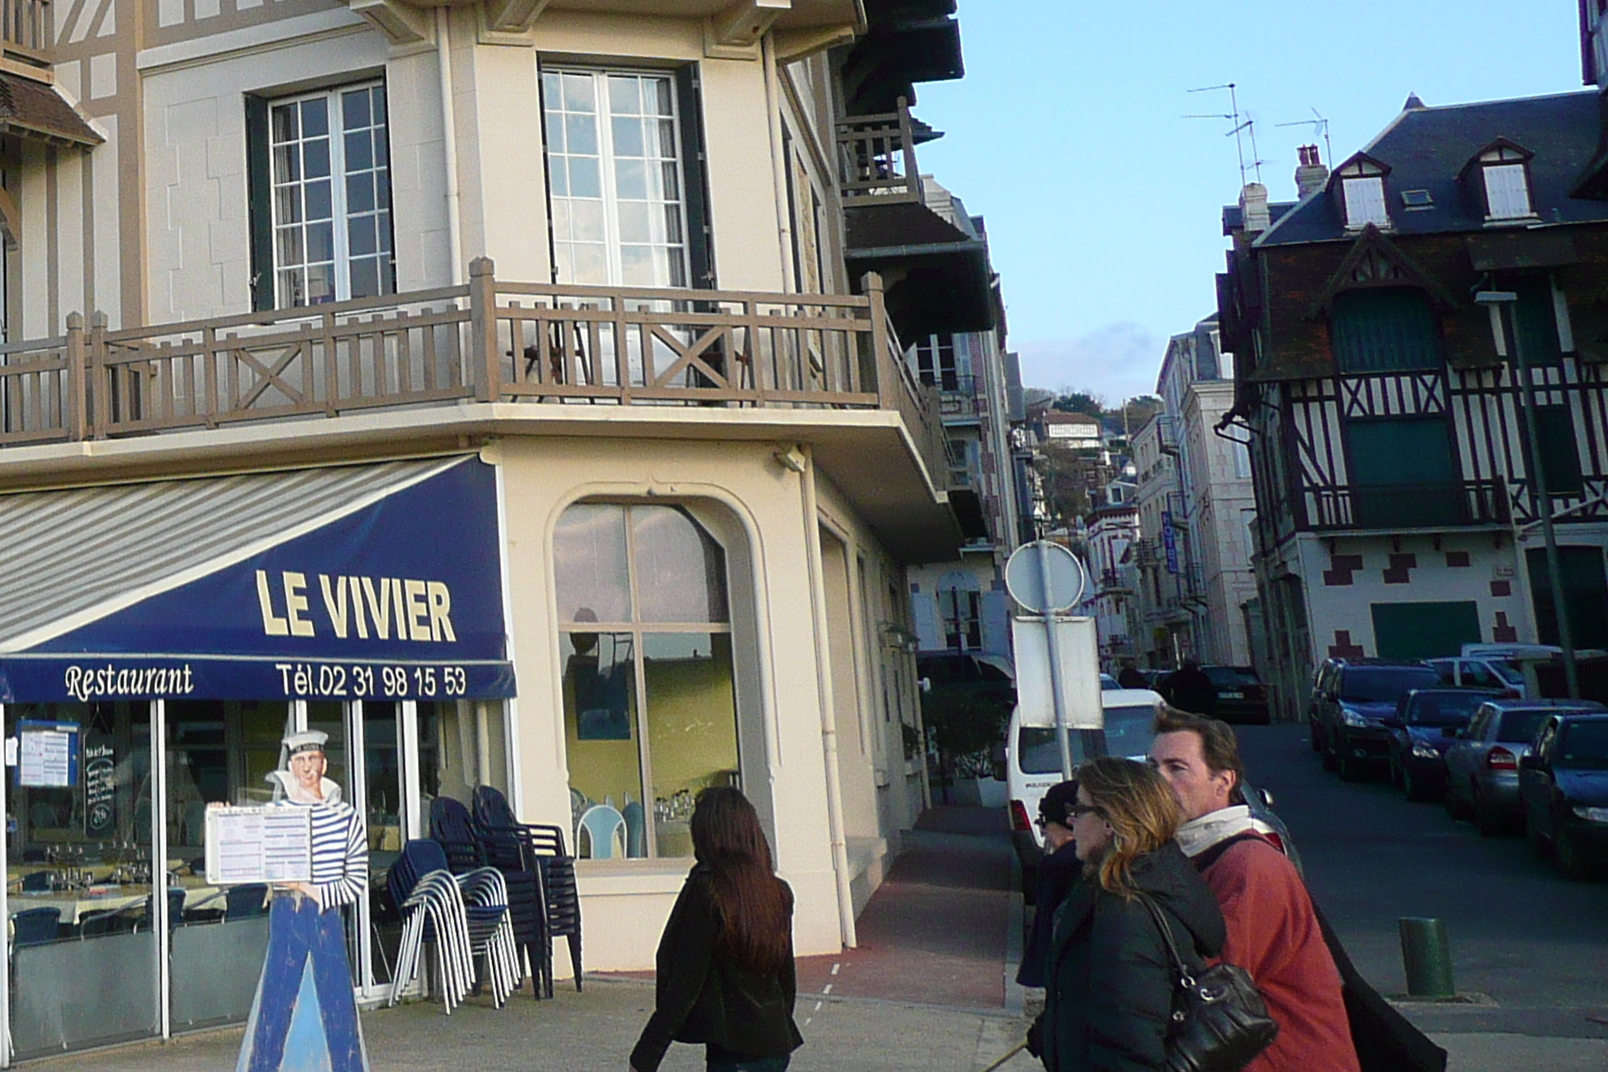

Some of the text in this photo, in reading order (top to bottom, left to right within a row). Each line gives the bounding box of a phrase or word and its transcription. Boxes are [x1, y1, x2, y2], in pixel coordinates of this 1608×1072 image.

[255, 569, 457, 643] LE VIVIER
[64, 662, 195, 702] Restaurant
[352, 665, 375, 696] 31
[381, 666, 409, 697] 98
[413, 667, 437, 697] 15
[442, 666, 467, 696] 53
